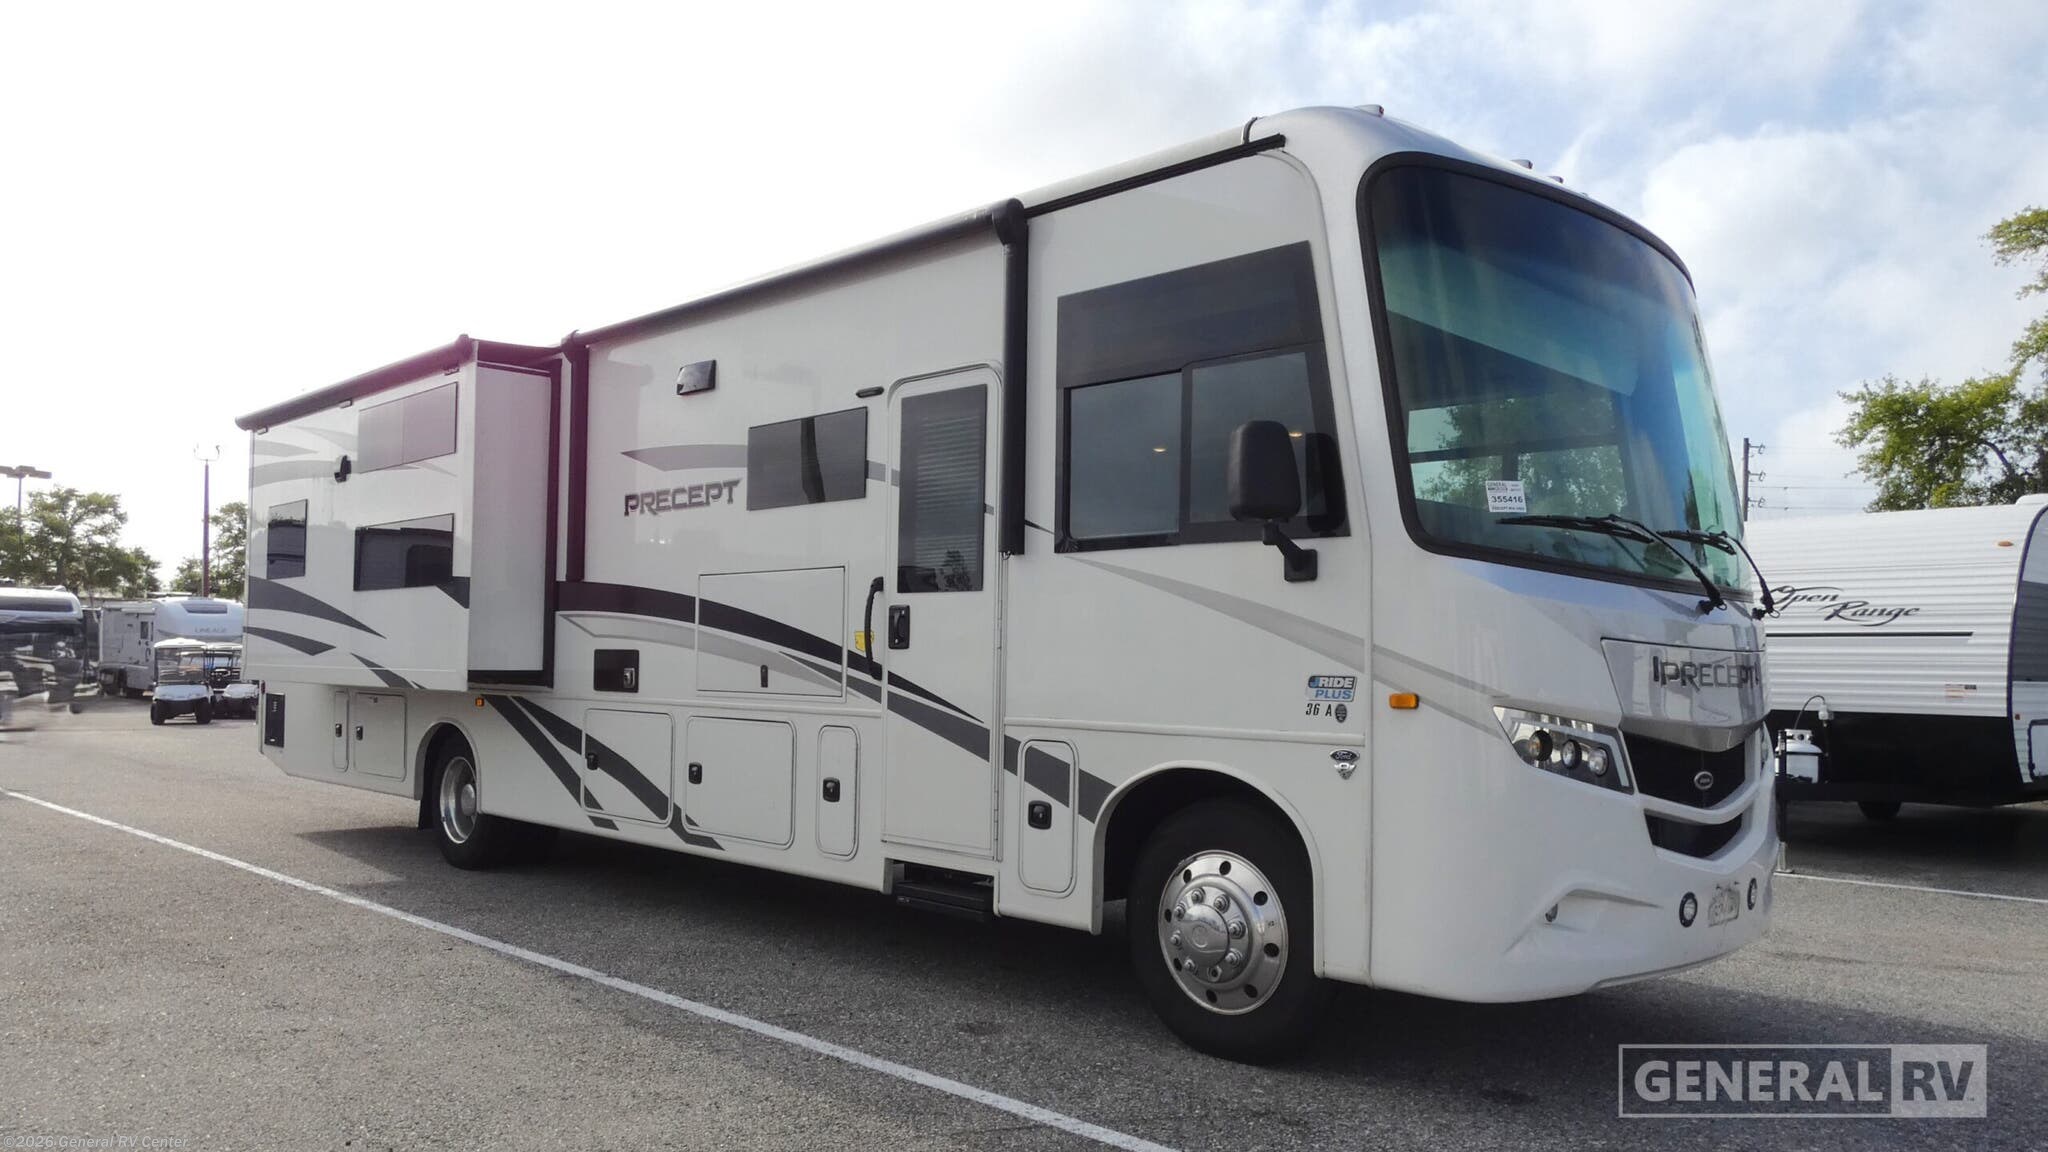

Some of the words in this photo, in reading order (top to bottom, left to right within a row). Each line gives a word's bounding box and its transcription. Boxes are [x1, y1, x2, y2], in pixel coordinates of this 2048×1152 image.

[624, 478, 743, 517] PRECEPT
[1491, 495, 1523, 503] 355416
[1816, 600, 1921, 627] Range
[1315, 689, 1353, 700] PLUS
[1305, 703, 1321, 716] 36
[1325, 703, 1333, 716] A
